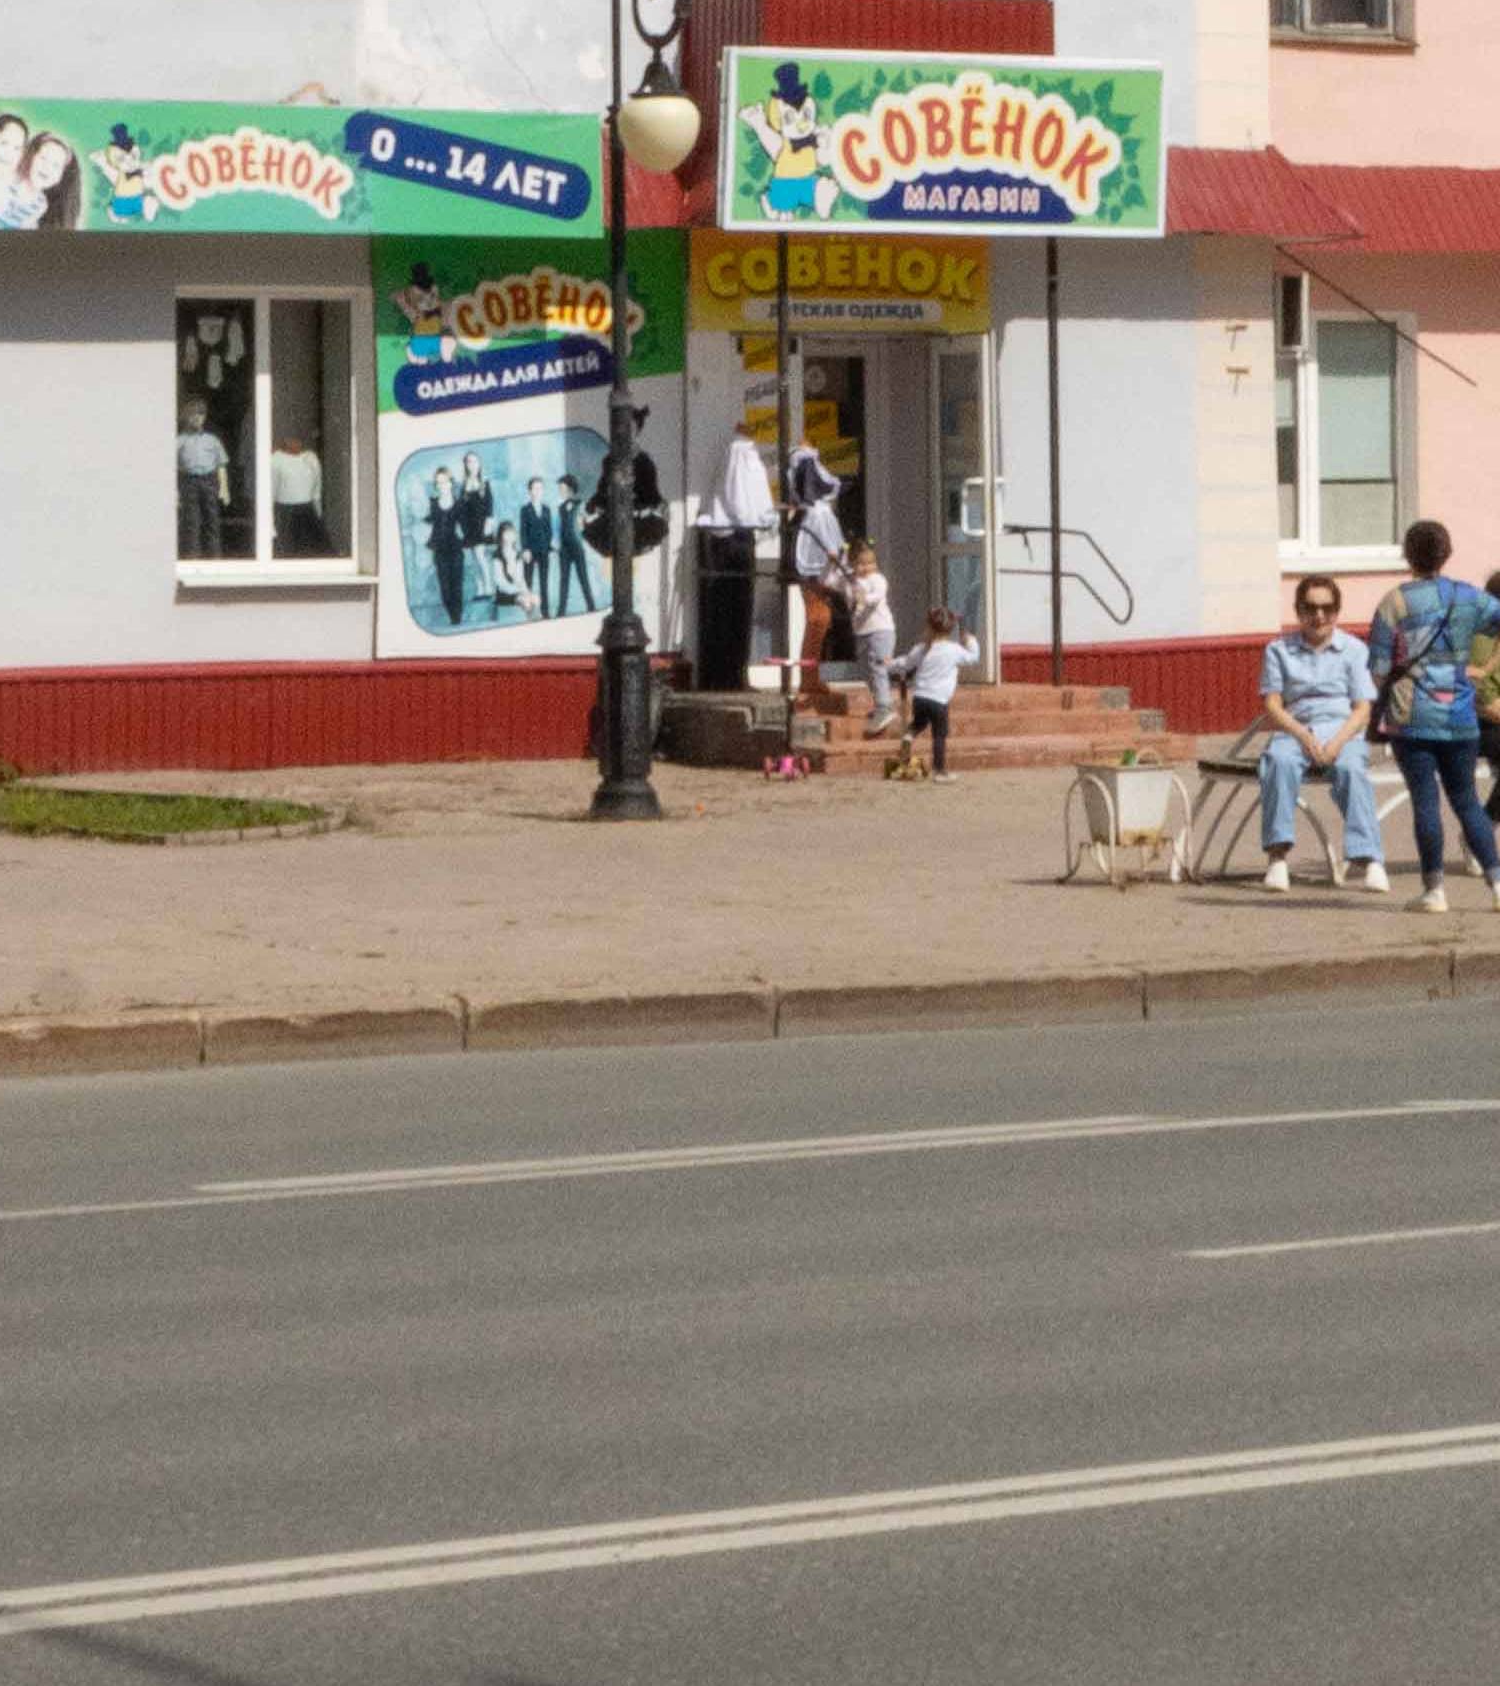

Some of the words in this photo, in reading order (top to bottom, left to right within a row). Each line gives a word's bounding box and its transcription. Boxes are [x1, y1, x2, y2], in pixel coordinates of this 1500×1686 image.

[841, 85, 1109, 201] СОВЁНОК
[158, 138, 346, 210] СОВЁНОК
[445, 146, 487, 186] 14
[492, 167, 569, 206] ЛЕТ
[902, 183, 1042, 213] МАГАЗИН
[456, 274, 639, 342] СОВЁНО
[769, 303, 845, 318] ДТСКАЯ
[848, 303, 924, 320] ОДЕЖДА
[416, 373, 498, 400] ОДЕЖДА
[499, 367, 542, 388] ДЛЯ
[543, 353, 600, 381] ДЕТЕЙ
